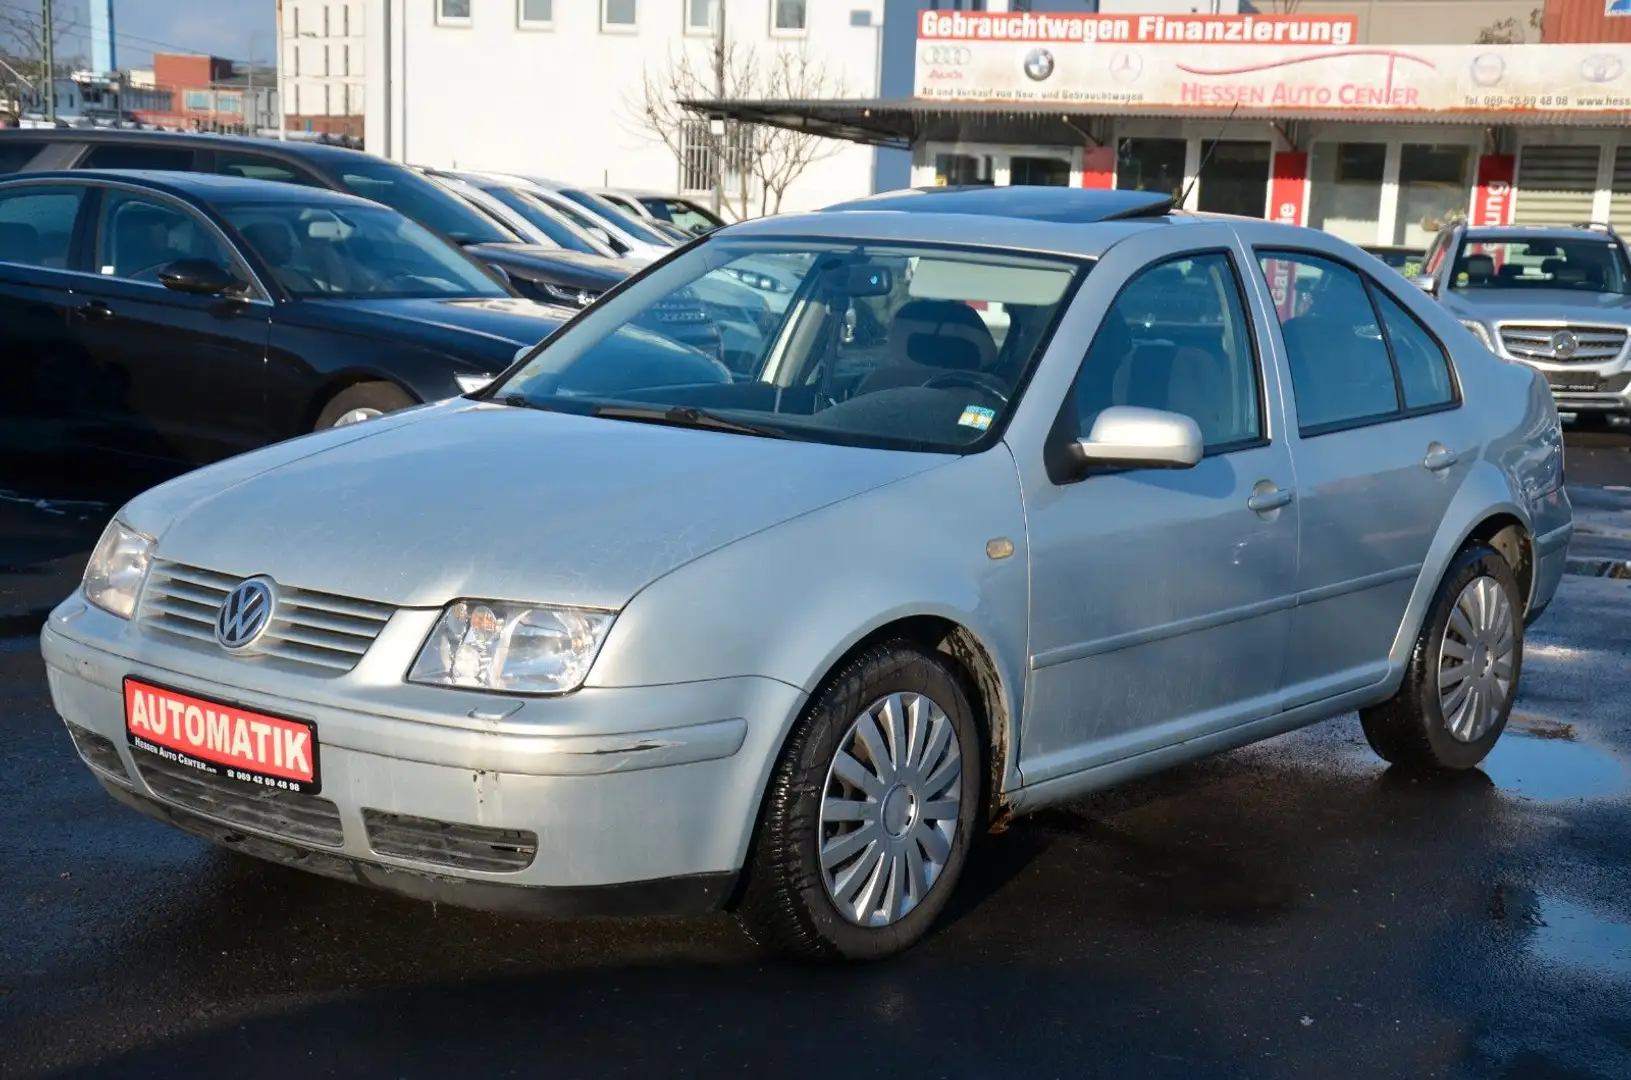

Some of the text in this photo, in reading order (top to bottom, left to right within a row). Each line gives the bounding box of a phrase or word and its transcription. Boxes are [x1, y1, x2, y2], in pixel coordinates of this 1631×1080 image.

[922, 11, 1353, 44] Gebrauchtwagen Finanzierung
[928, 68, 963, 80] Audi
[132, 688, 309, 774] AUTOMATIK
[236, 772, 251, 782] 069
[252, 775, 263, 785] 42
[276, 779, 288, 789] 48
[289, 781, 300, 792] 98
